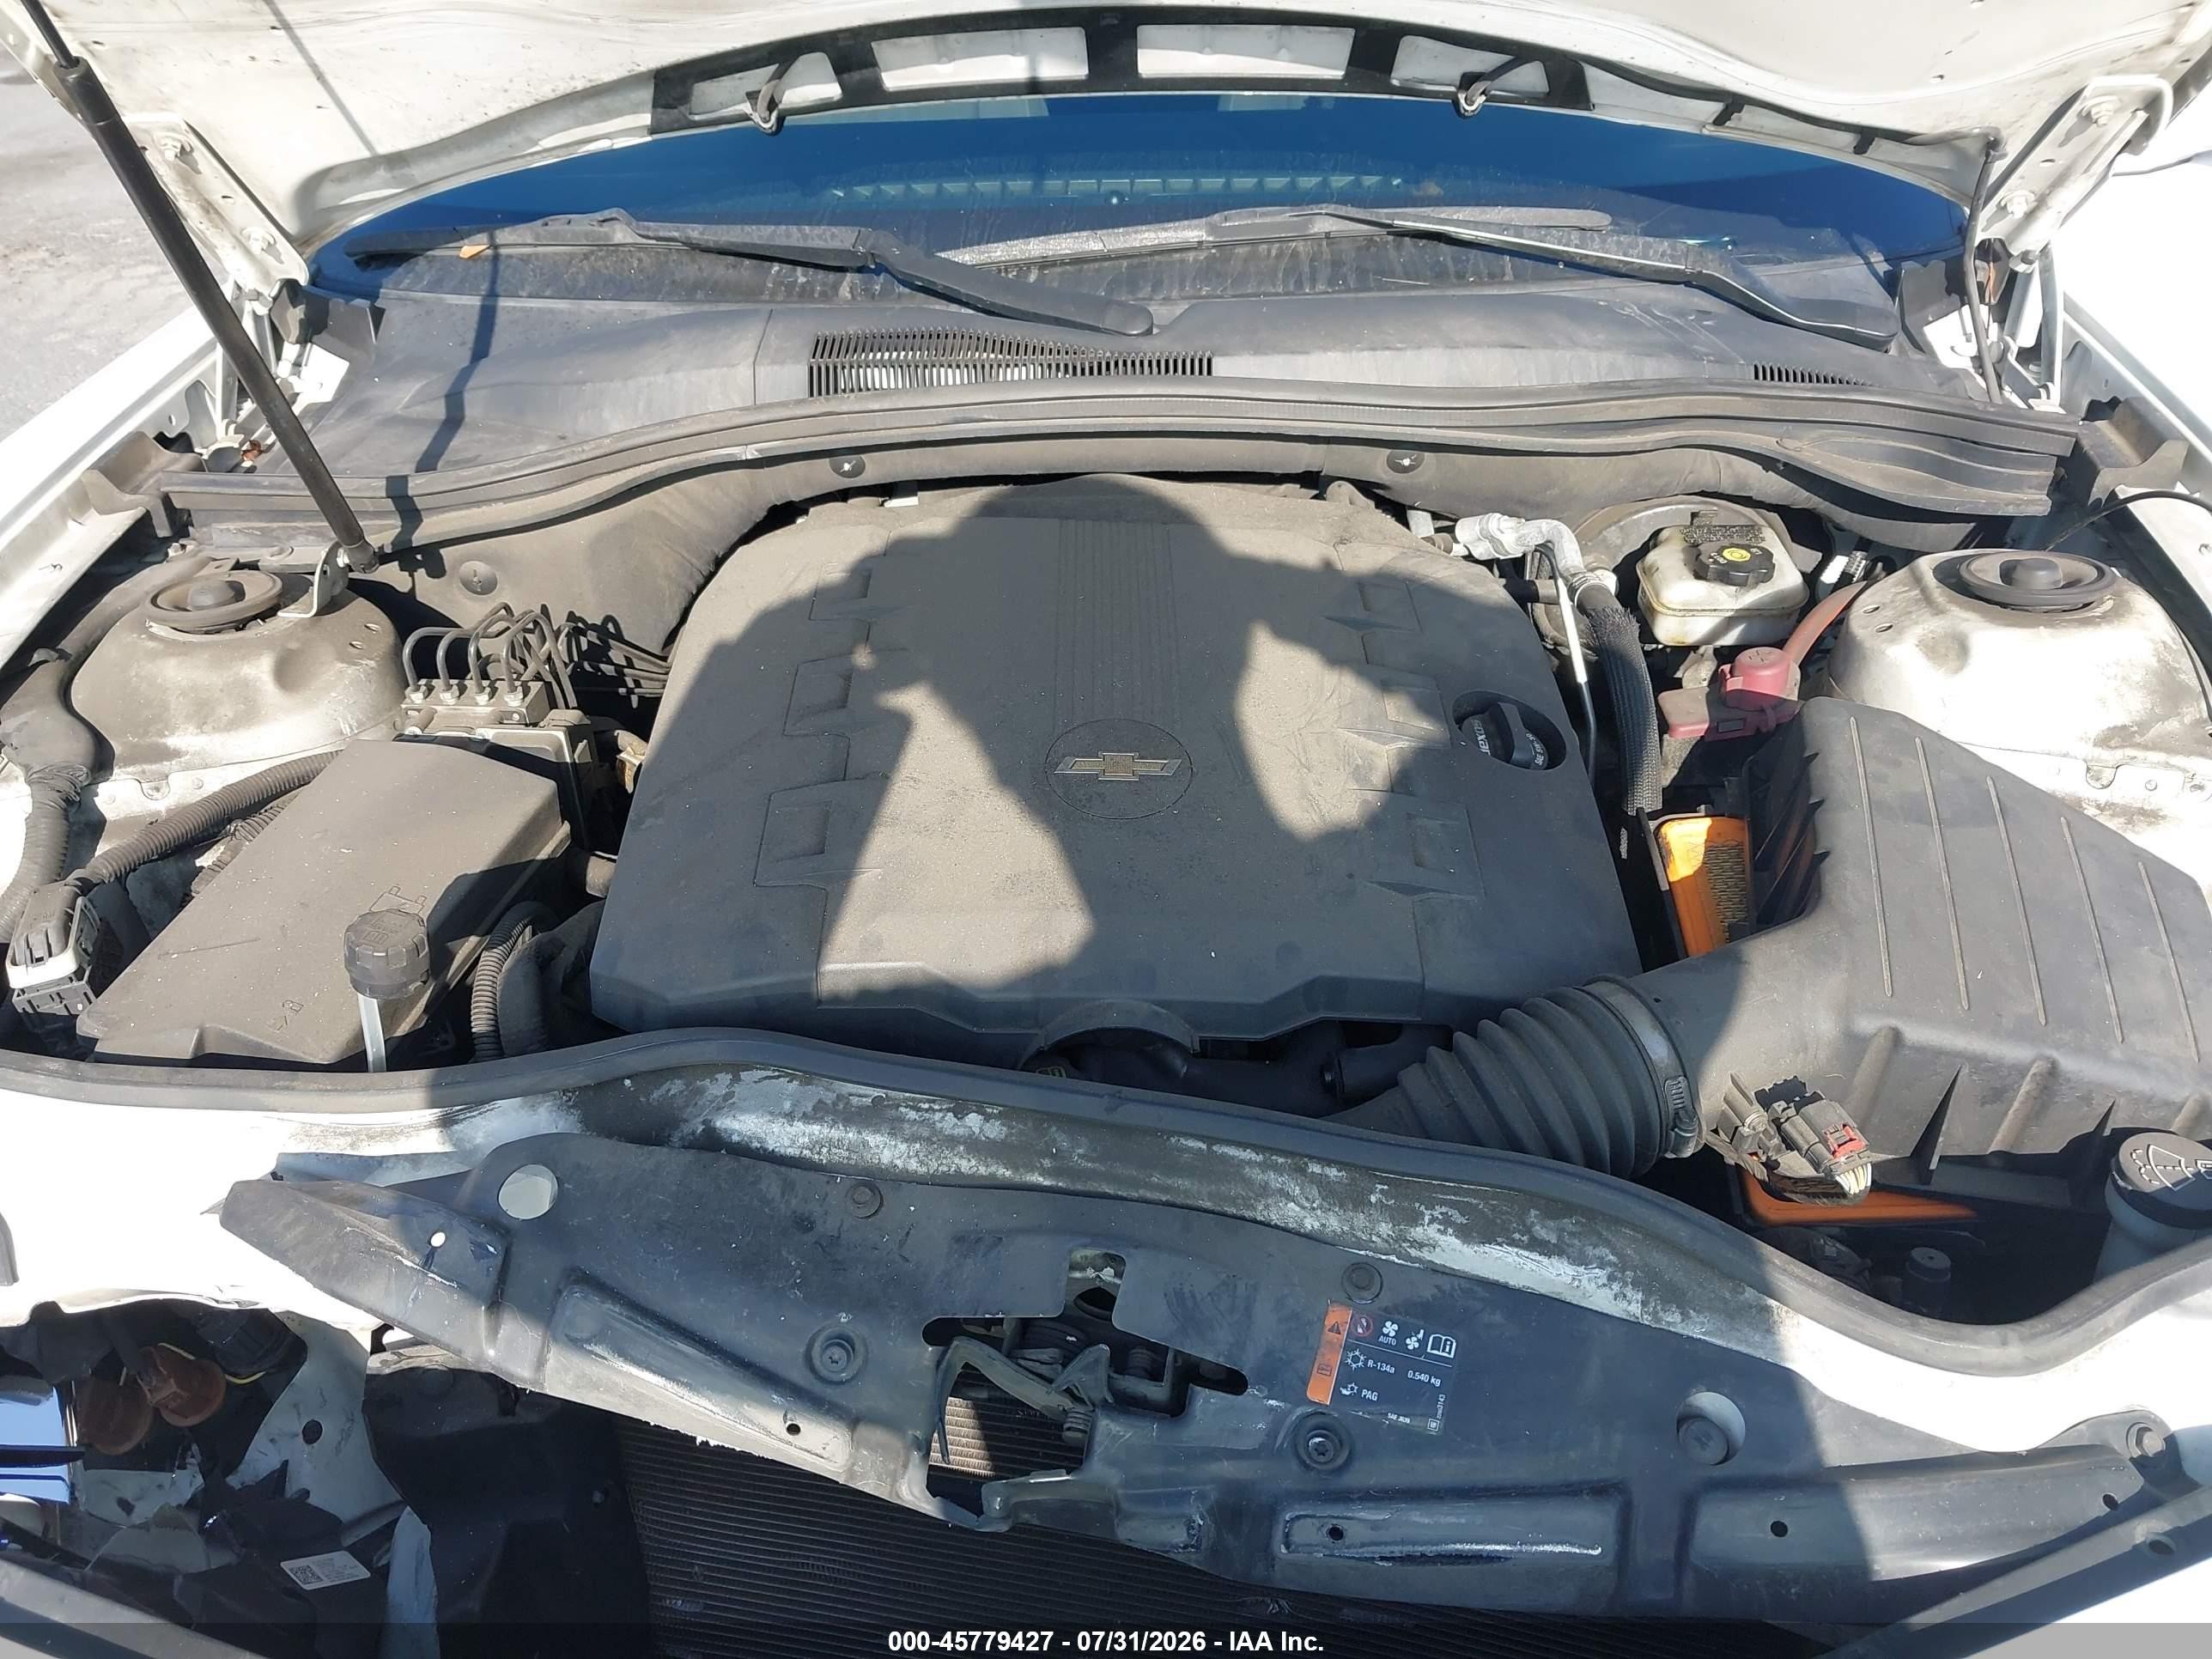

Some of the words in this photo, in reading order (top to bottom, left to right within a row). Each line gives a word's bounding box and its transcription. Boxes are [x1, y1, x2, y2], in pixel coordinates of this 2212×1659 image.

[1378, 1335, 1397, 1346] AUTO
[1367, 1359, 1395, 1374] R-134a
[1407, 1370, 1430, 1382] 0.540
[1430, 1376, 1441, 1387] kg
[1361, 1389, 1378, 1401] PAG
